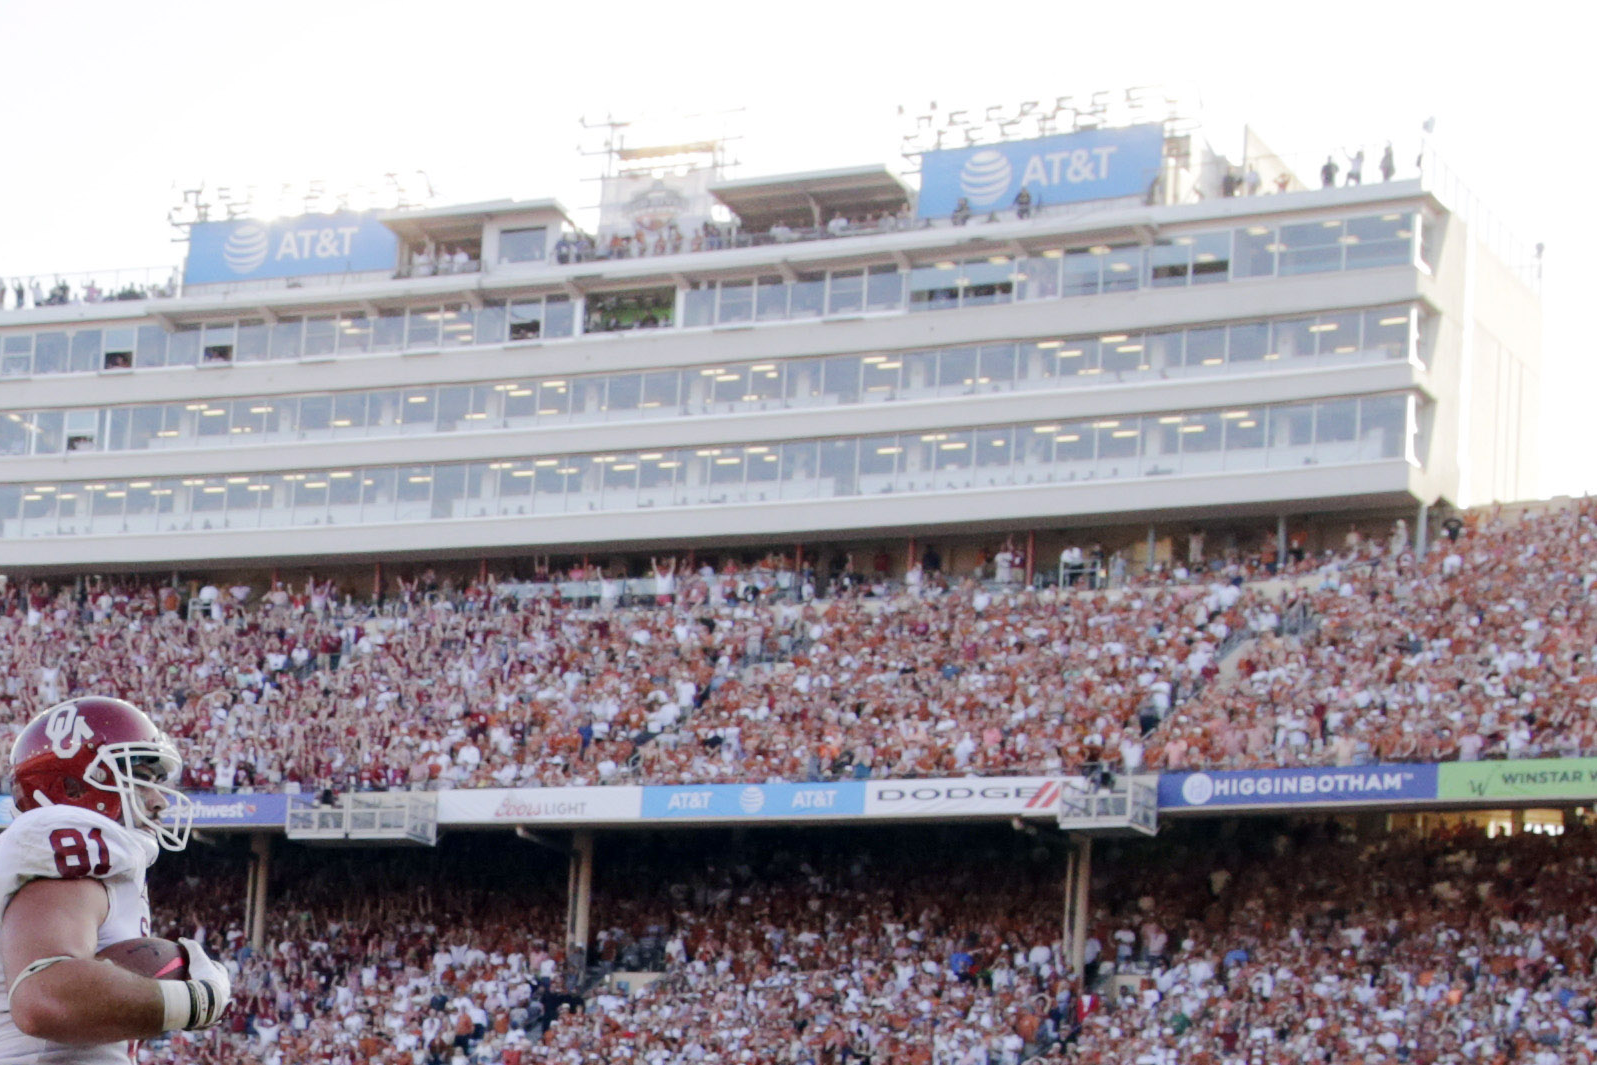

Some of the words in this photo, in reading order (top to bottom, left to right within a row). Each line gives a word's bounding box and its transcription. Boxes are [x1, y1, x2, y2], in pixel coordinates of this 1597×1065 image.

[1021, 144, 1118, 189] AT&T
[276, 225, 358, 261] AT&T
[1214, 773, 1402, 796] HIGGINBOTHAM
[1502, 770, 1583, 785] WINSTAR
[667, 791, 714, 810] AT&T
[791, 789, 838, 808] AT&T
[877, 786, 1040, 801] DODGE
[544, 801, 587, 816] LIGHT
[49, 827, 113, 880] 81
